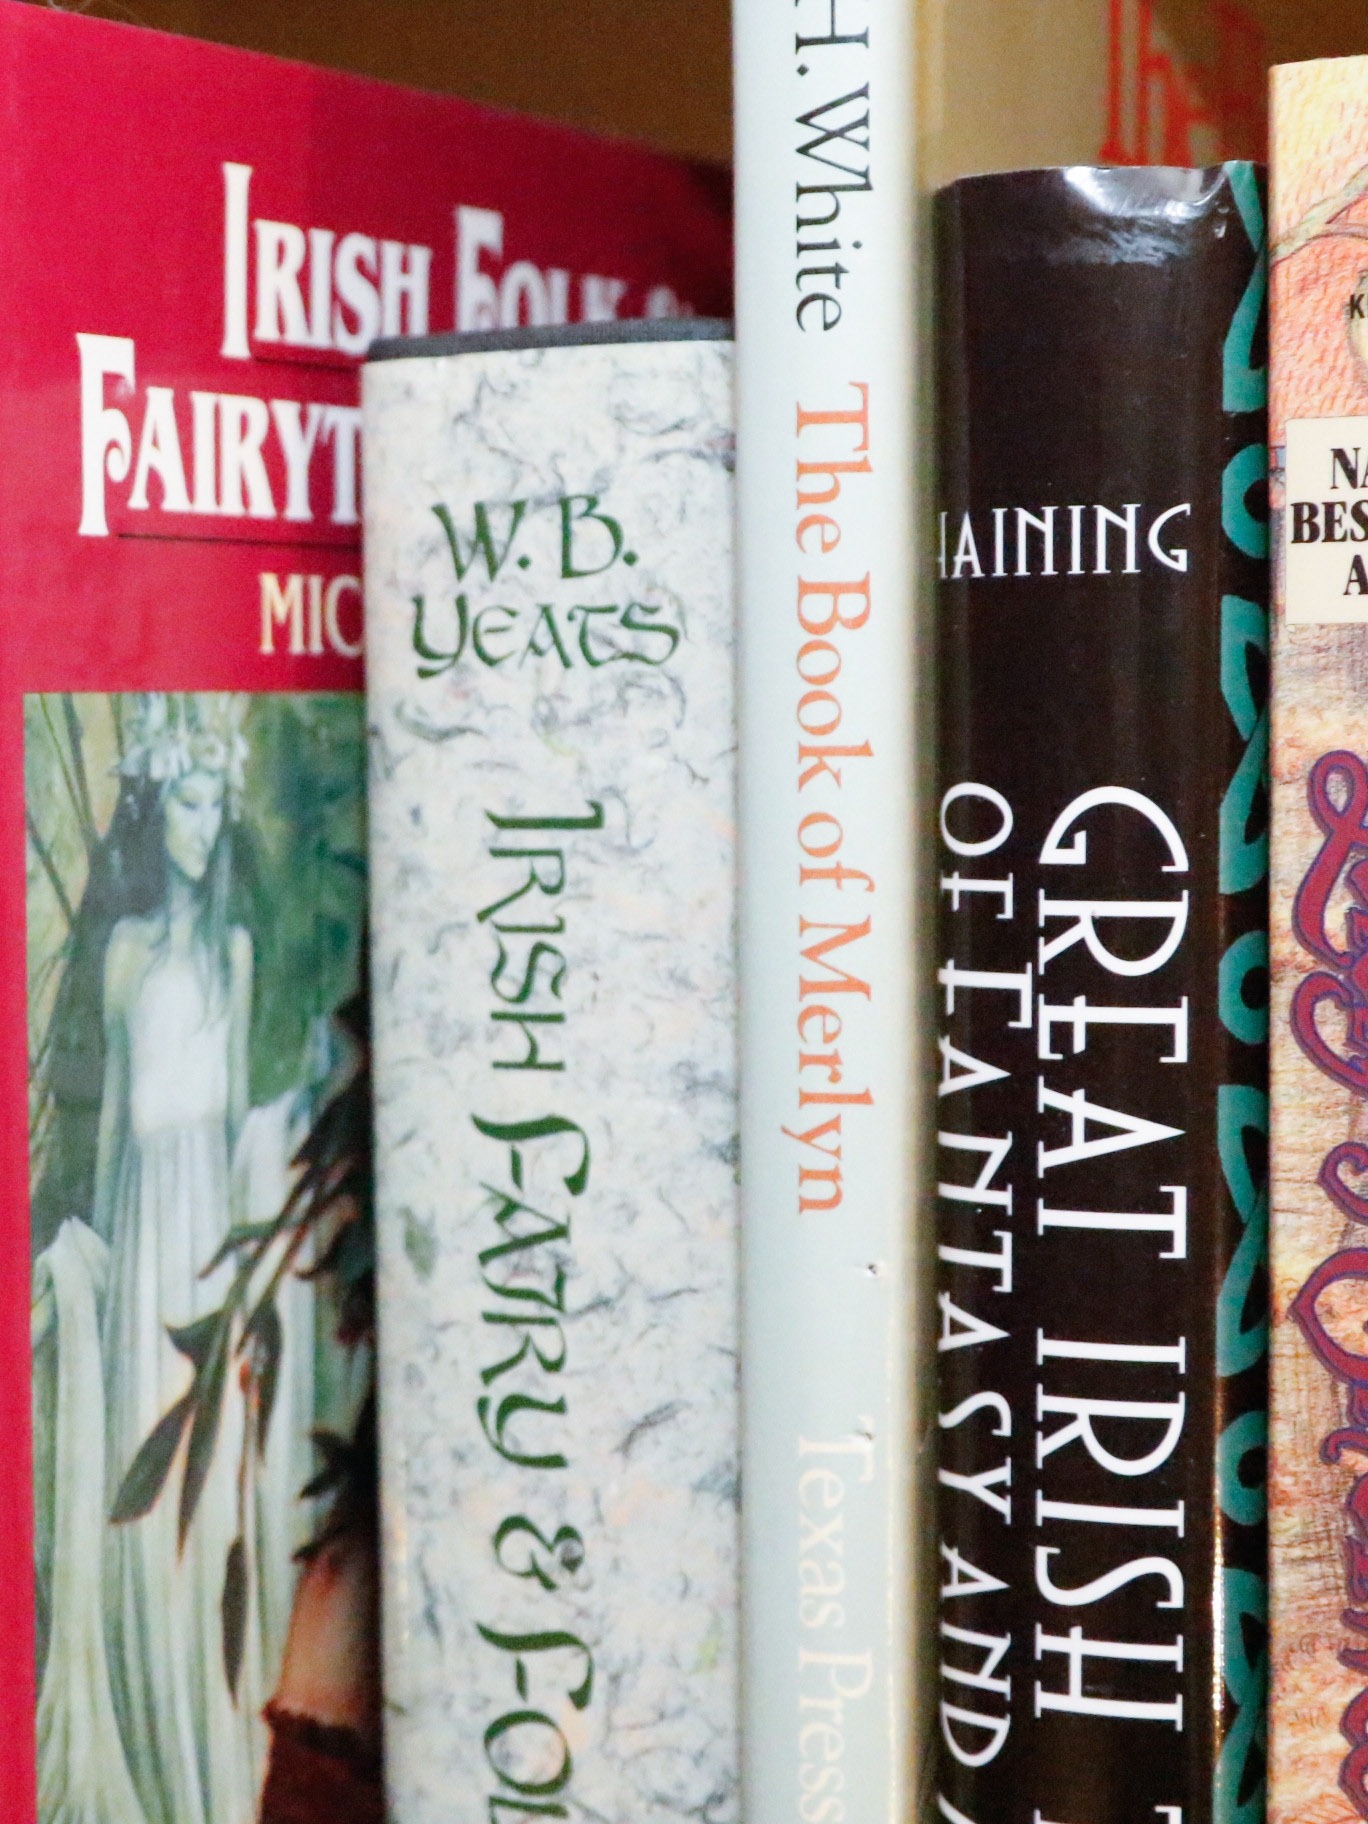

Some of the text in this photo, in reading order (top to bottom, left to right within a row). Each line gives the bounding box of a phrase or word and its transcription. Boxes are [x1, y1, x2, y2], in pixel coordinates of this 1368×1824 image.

[221, 161, 432, 359] IRISH
[794, 81, 874, 332] White
[795, 381, 873, 554] The
[411, 592, 681, 679] YEATS
[796, 571, 874, 793] Book
[476, 800, 604, 1072] IRISH
[795, 811, 874, 898] of
[939, 782, 1016, 920] OF
[780, 914, 874, 1215] Merlyn
[1037, 785, 1189, 1260] GREAT
[470, 1112, 592, 1470] FAIRY
[938, 958, 1032, 1525] FANTASY
[492, 1515, 585, 1592] &
[797, 1415, 875, 1628] Texas
[1035, 1327, 1186, 1732] IRISH
[797, 1648, 874, 1824] Press
[940, 1541, 1012, 1768] AND
